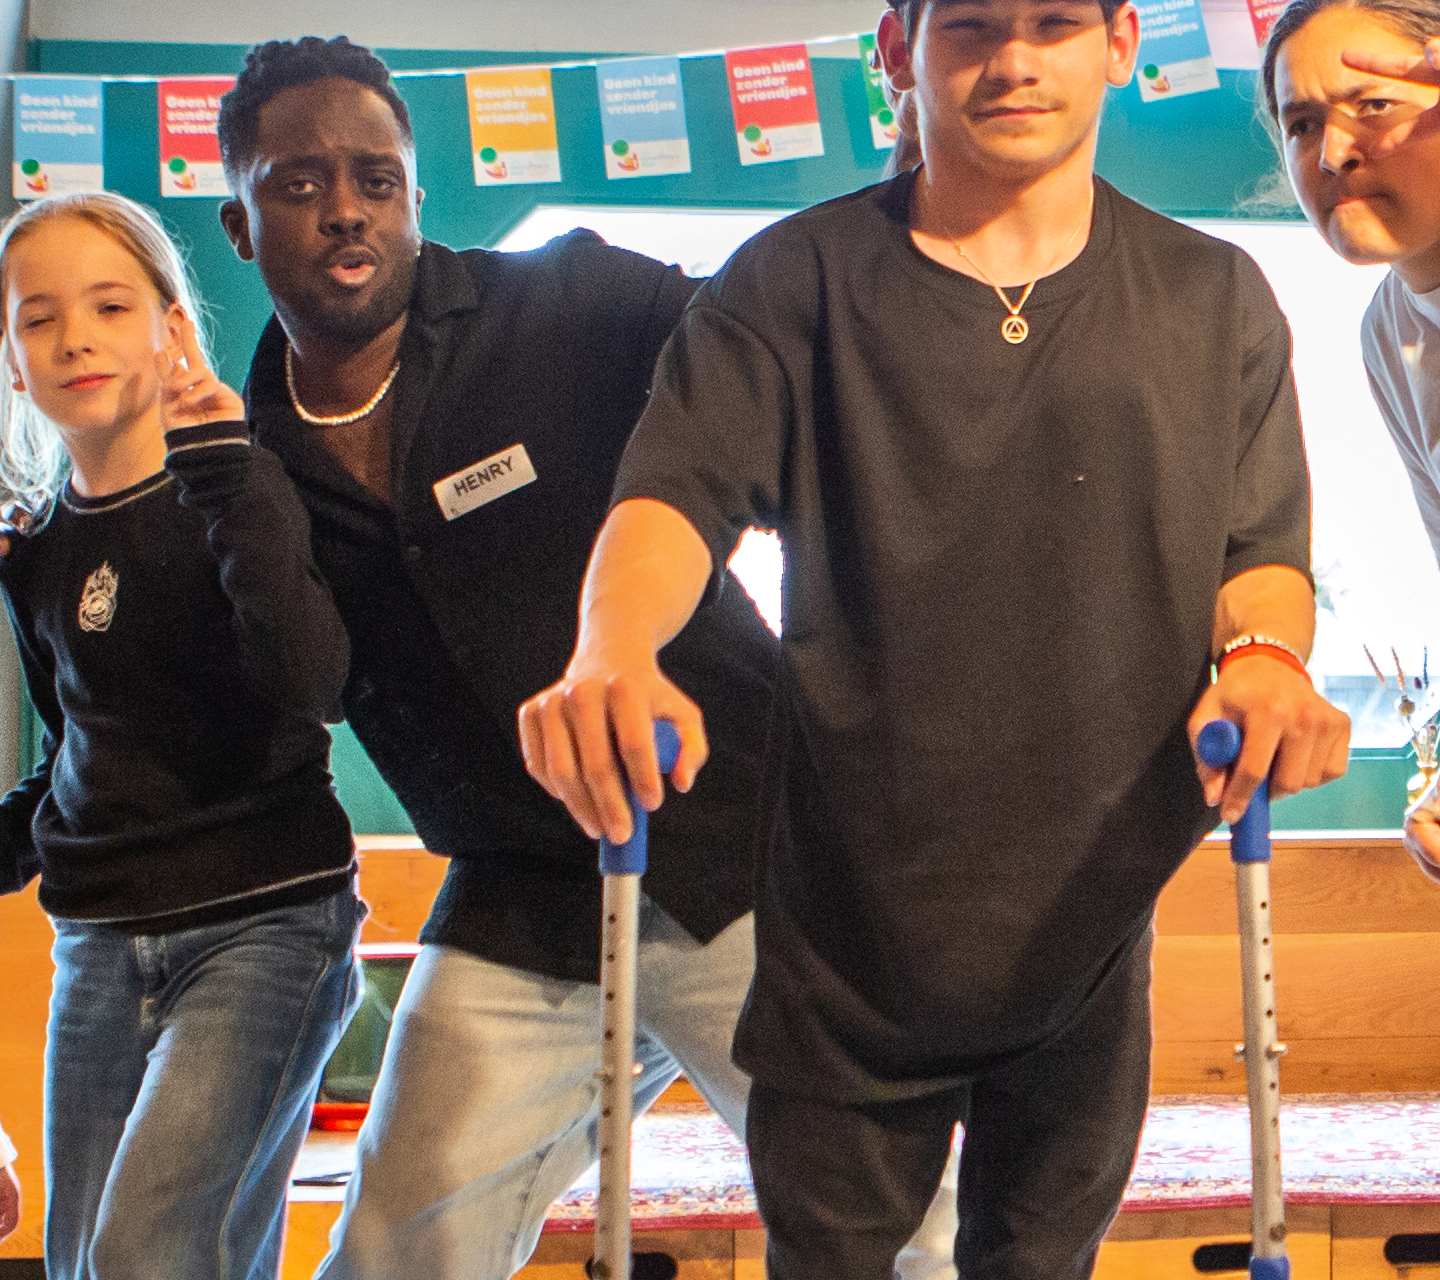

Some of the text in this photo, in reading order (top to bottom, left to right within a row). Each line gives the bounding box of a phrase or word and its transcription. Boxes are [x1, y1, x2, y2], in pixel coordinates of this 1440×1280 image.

[1138, 3, 1163, 17] een
[1143, 22, 1199, 40] riendjes
[732, 59, 805, 79] Geen kind
[736, 75, 788, 91] zonder
[165, 96, 206, 109] Geen
[737, 86, 807, 104] vriendjes
[453, 455, 514, 497] HENRY
